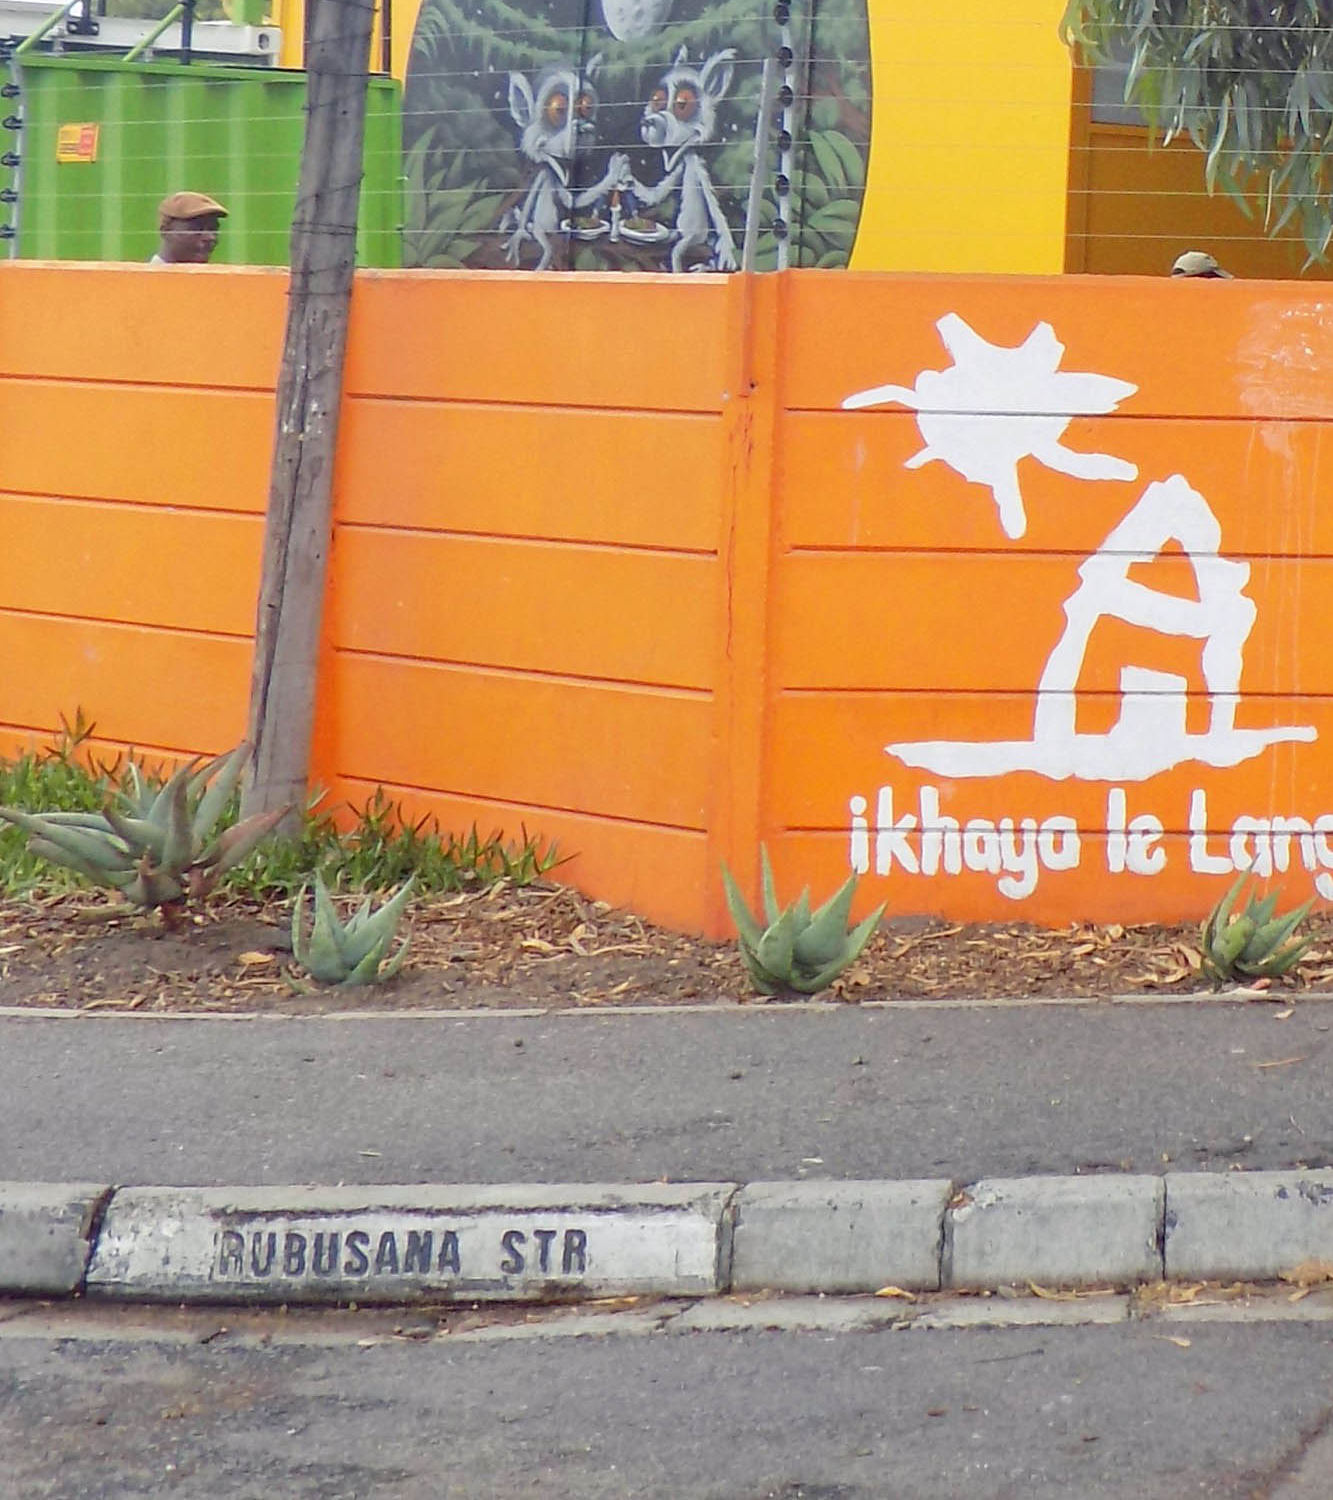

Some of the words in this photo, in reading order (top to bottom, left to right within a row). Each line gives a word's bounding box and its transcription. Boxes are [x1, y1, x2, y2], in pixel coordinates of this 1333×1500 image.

[849, 786, 1081, 900] ikhaya
[1107, 787, 1168, 875] le
[217, 1229, 461, 1277] RUBUSANA
[501, 1229, 588, 1276] STR
